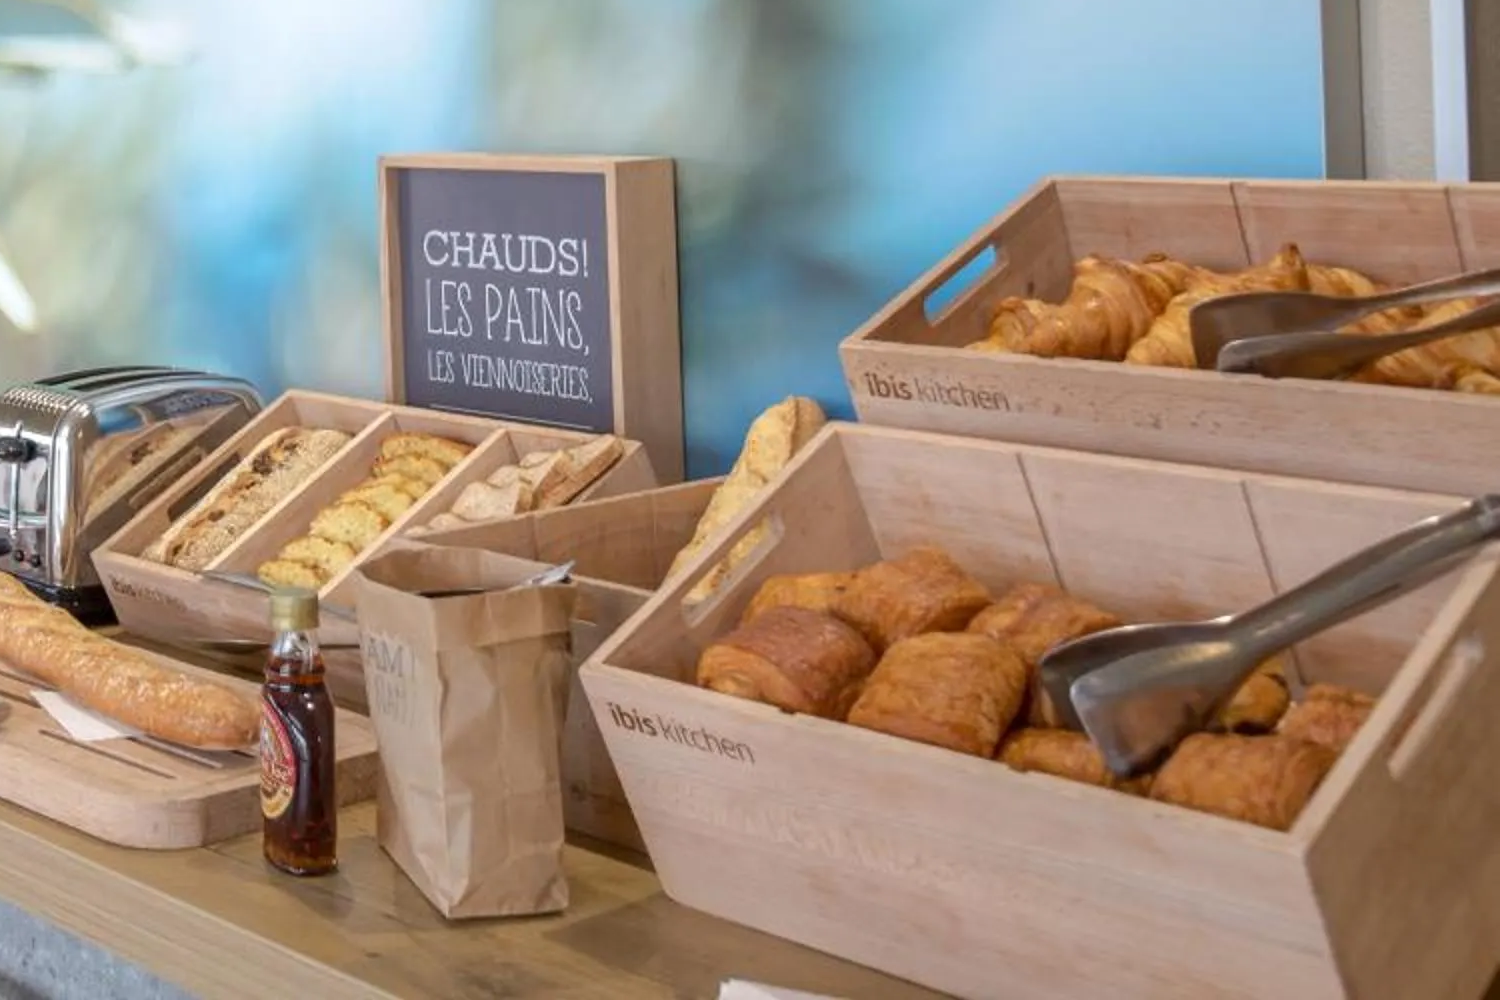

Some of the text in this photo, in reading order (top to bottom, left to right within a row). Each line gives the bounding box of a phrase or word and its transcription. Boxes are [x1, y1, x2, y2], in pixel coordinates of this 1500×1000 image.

[423, 229, 589, 278] CHAUDS!
[425, 277, 590, 356] LES PAINS,
[427, 350, 455, 383] LES
[864, 372, 1010, 413] ibis kitchen
[607, 702, 756, 764] ibis kitchen
